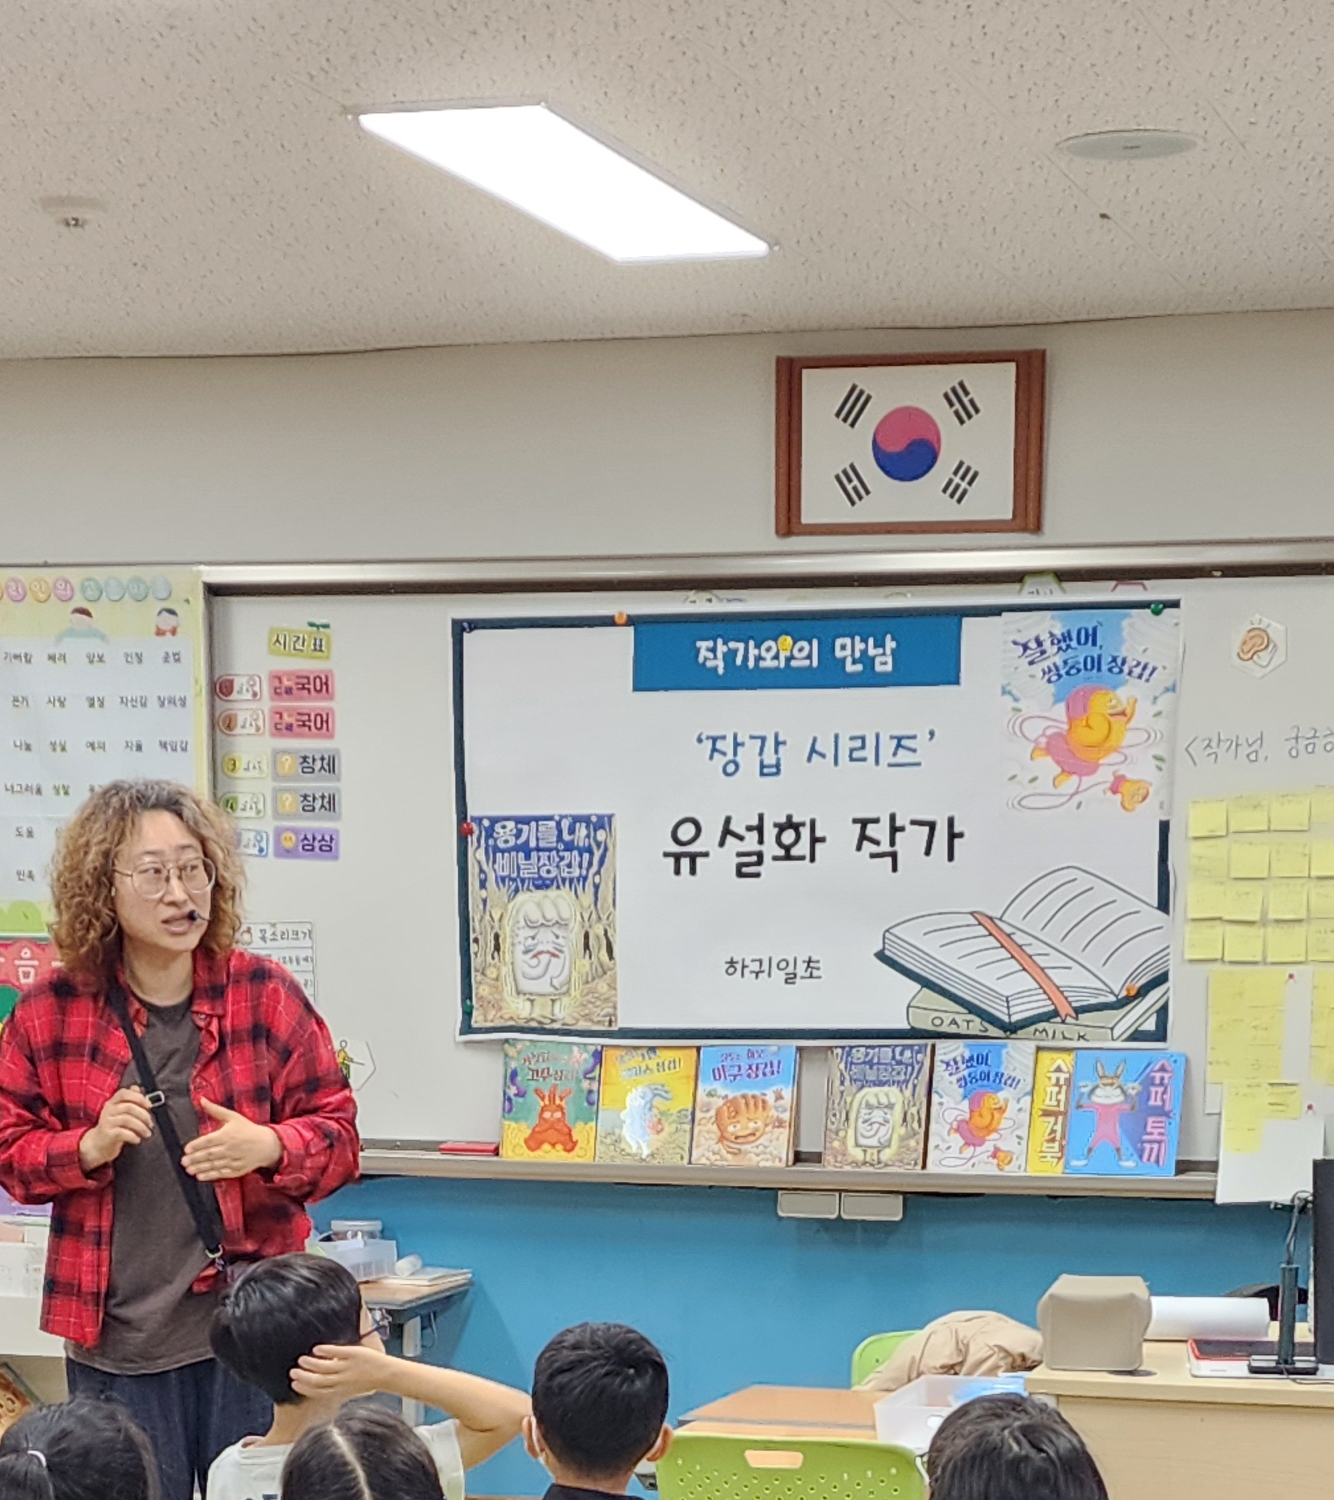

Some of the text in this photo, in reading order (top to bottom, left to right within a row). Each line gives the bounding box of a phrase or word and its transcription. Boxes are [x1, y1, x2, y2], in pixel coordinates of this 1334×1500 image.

[272, 632, 325, 653] 시간표
[695, 633, 897, 675] 작가와의 만남
[1011, 625, 1104, 666] 잘했어,
[1041, 653, 1158, 685] 쌍둥이 장갑!
[295, 676, 330, 695] 국어
[295, 713, 330, 732] 국어
[299, 754, 336, 774] 창체
[299, 792, 337, 813] 창체
[493, 820, 559, 850] 용기를
[662, 812, 964, 879] 유설화 작가
[494, 850, 588, 880] 비닐장갑!
[725, 955, 823, 985] 하귀일초
[931, 1016, 1090, 1042] OATS MILK
[1044, 1058, 1069, 1111] 슈퍼
[1148, 1059, 1174, 1111] 슈퍼
[1038, 1115, 1063, 1167] 거북
[1141, 1116, 1170, 1167] 토끼
